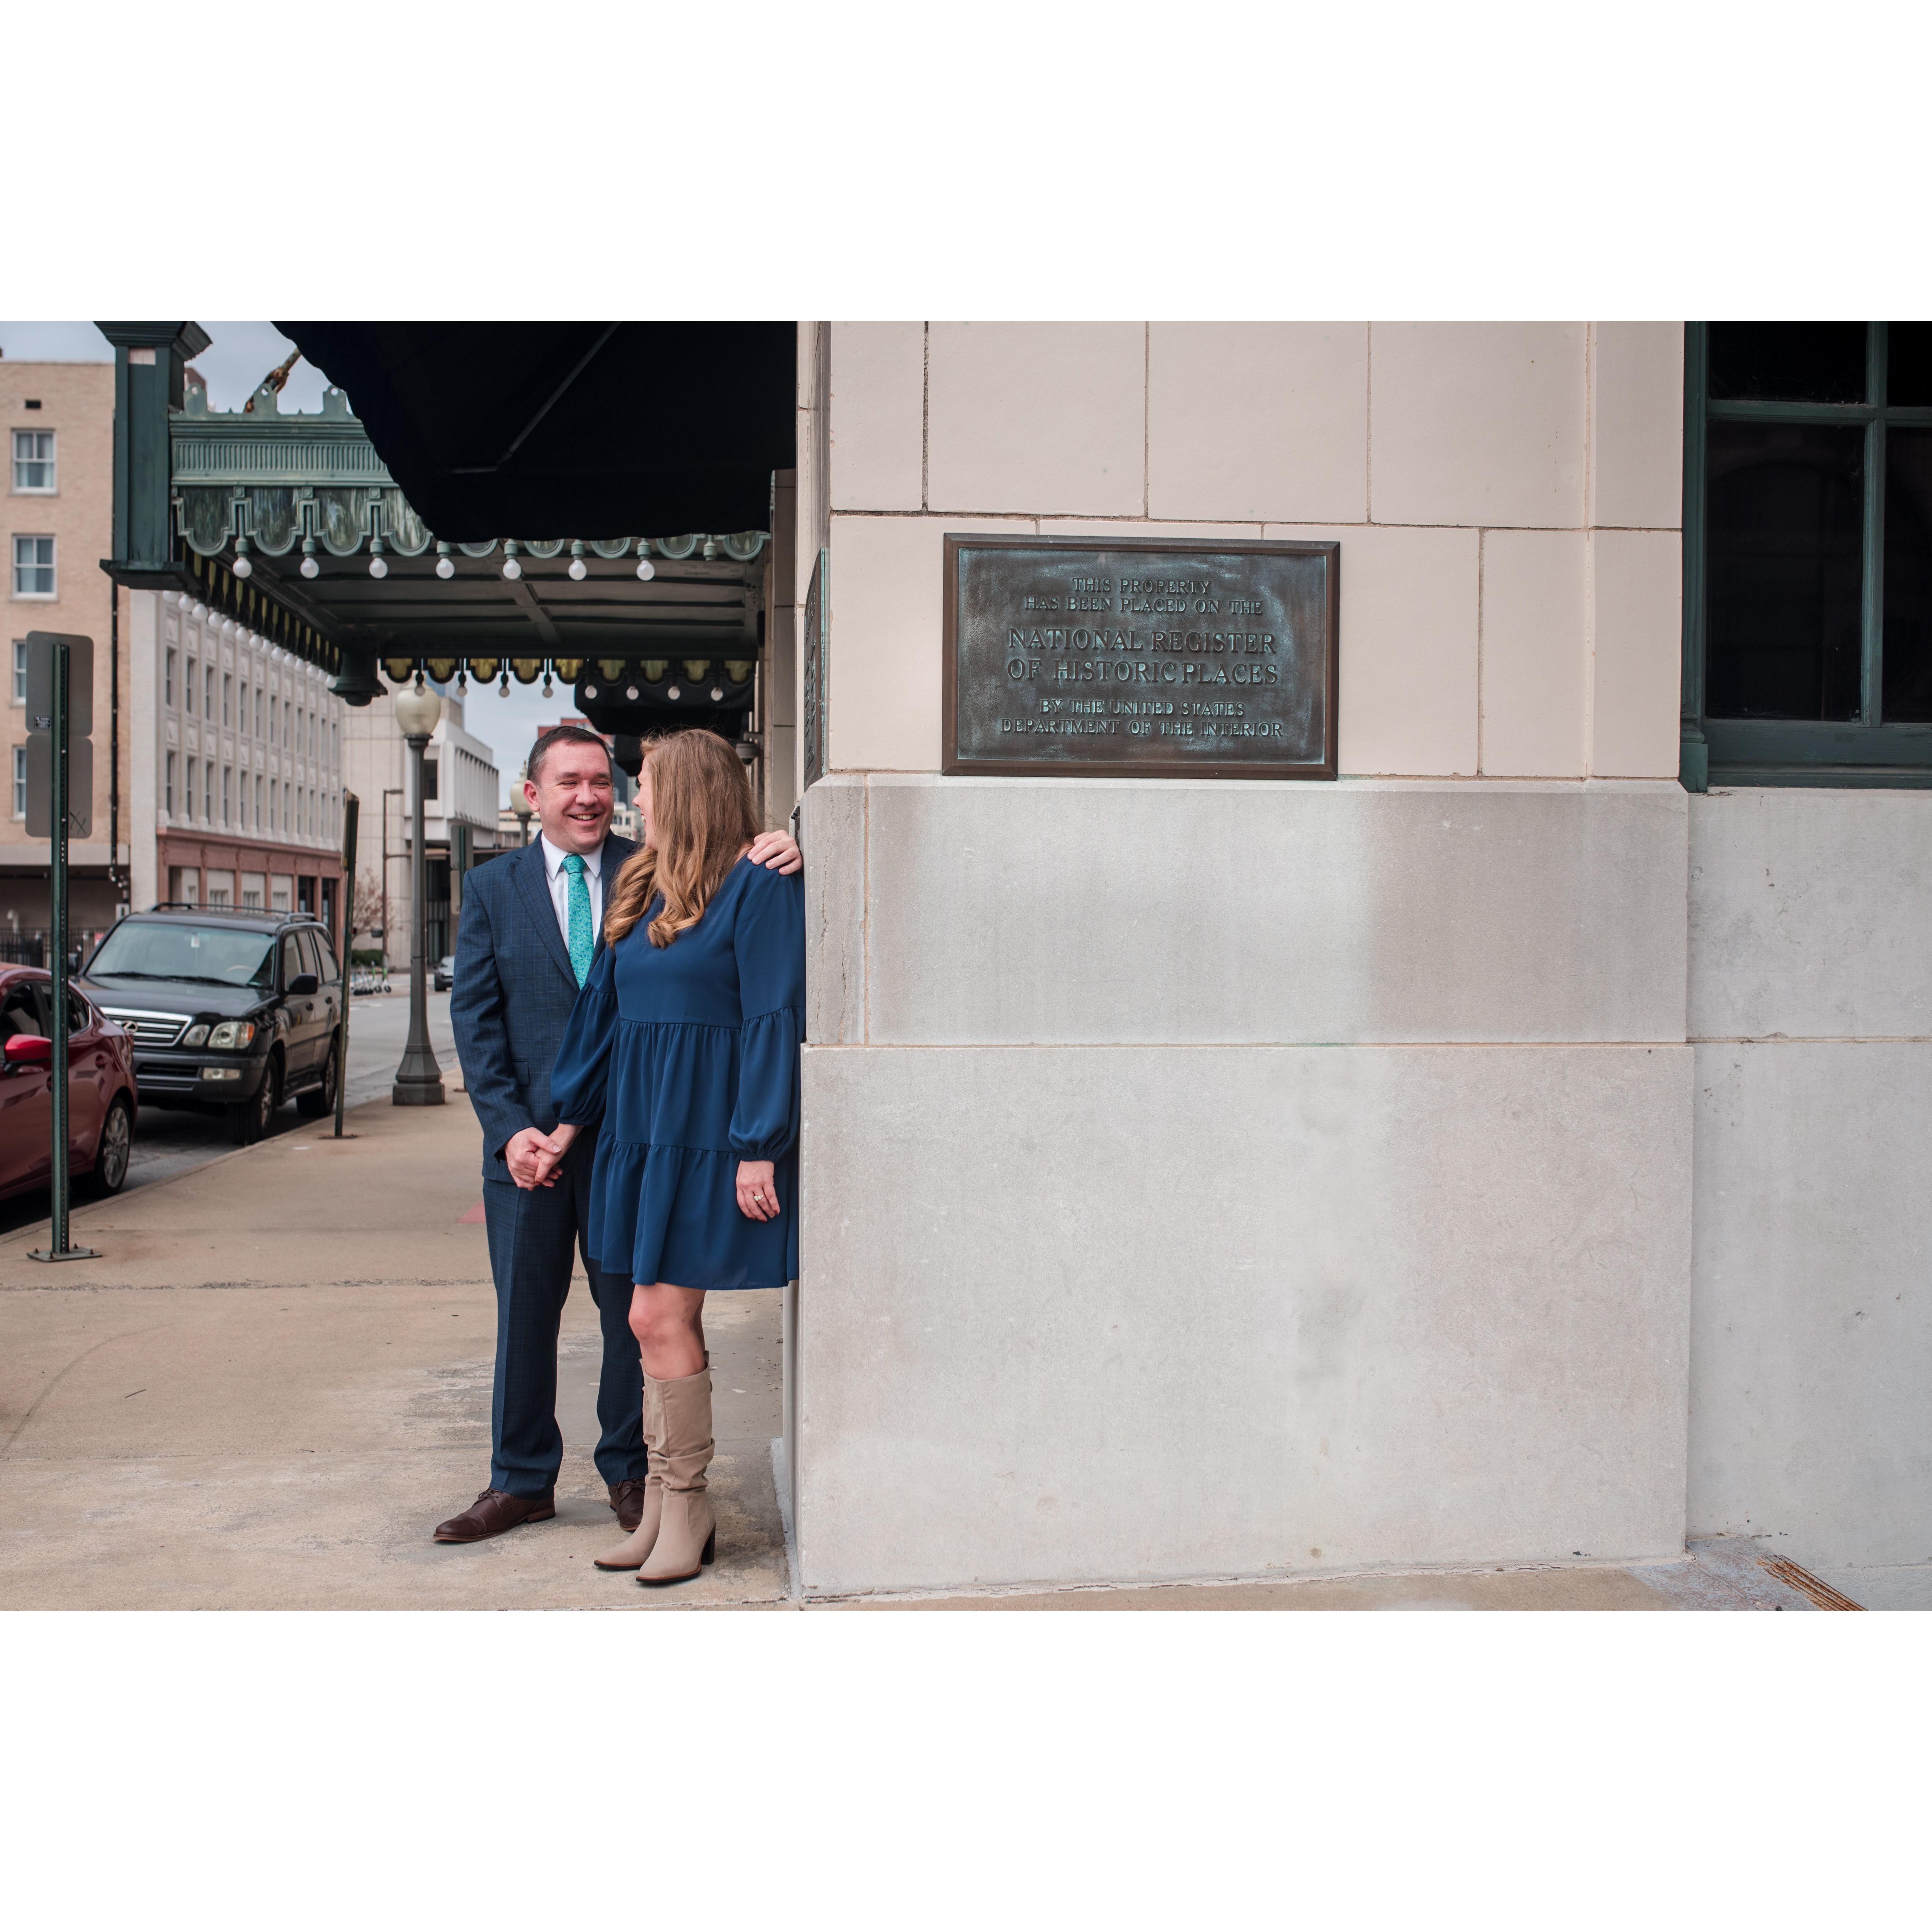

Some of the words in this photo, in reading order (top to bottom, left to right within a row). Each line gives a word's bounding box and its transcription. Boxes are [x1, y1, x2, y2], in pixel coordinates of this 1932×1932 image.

[1072, 577, 1111, 592] THIS
[1120, 579, 1211, 594] PROPERTY
[1025, 595, 1059, 610] HAS
[1067, 597, 1111, 611] BEEN
[1120, 598, 1187, 613] PLACED
[1195, 599, 1220, 614] ON
[1229, 600, 1263, 615] THE
[1009, 627, 1143, 651] NATIONAL
[1152, 631, 1276, 654] REGISTER
[1007, 659, 1042, 680] OF
[1054, 660, 1176, 683] HISTORIC
[1182, 663, 1277, 685] PLACES
[1040, 699, 1063, 713] BY
[1069, 699, 1104, 714] THE
[1110, 700, 1175, 715] UNITED
[1181, 701, 1245, 717] STATES
[1001, 718, 1120, 734] DEPARTMENT
[1128, 720, 1152, 735] OF
[1159, 721, 1193, 736] THE
[1201, 722, 1283, 737] INTERIOR
